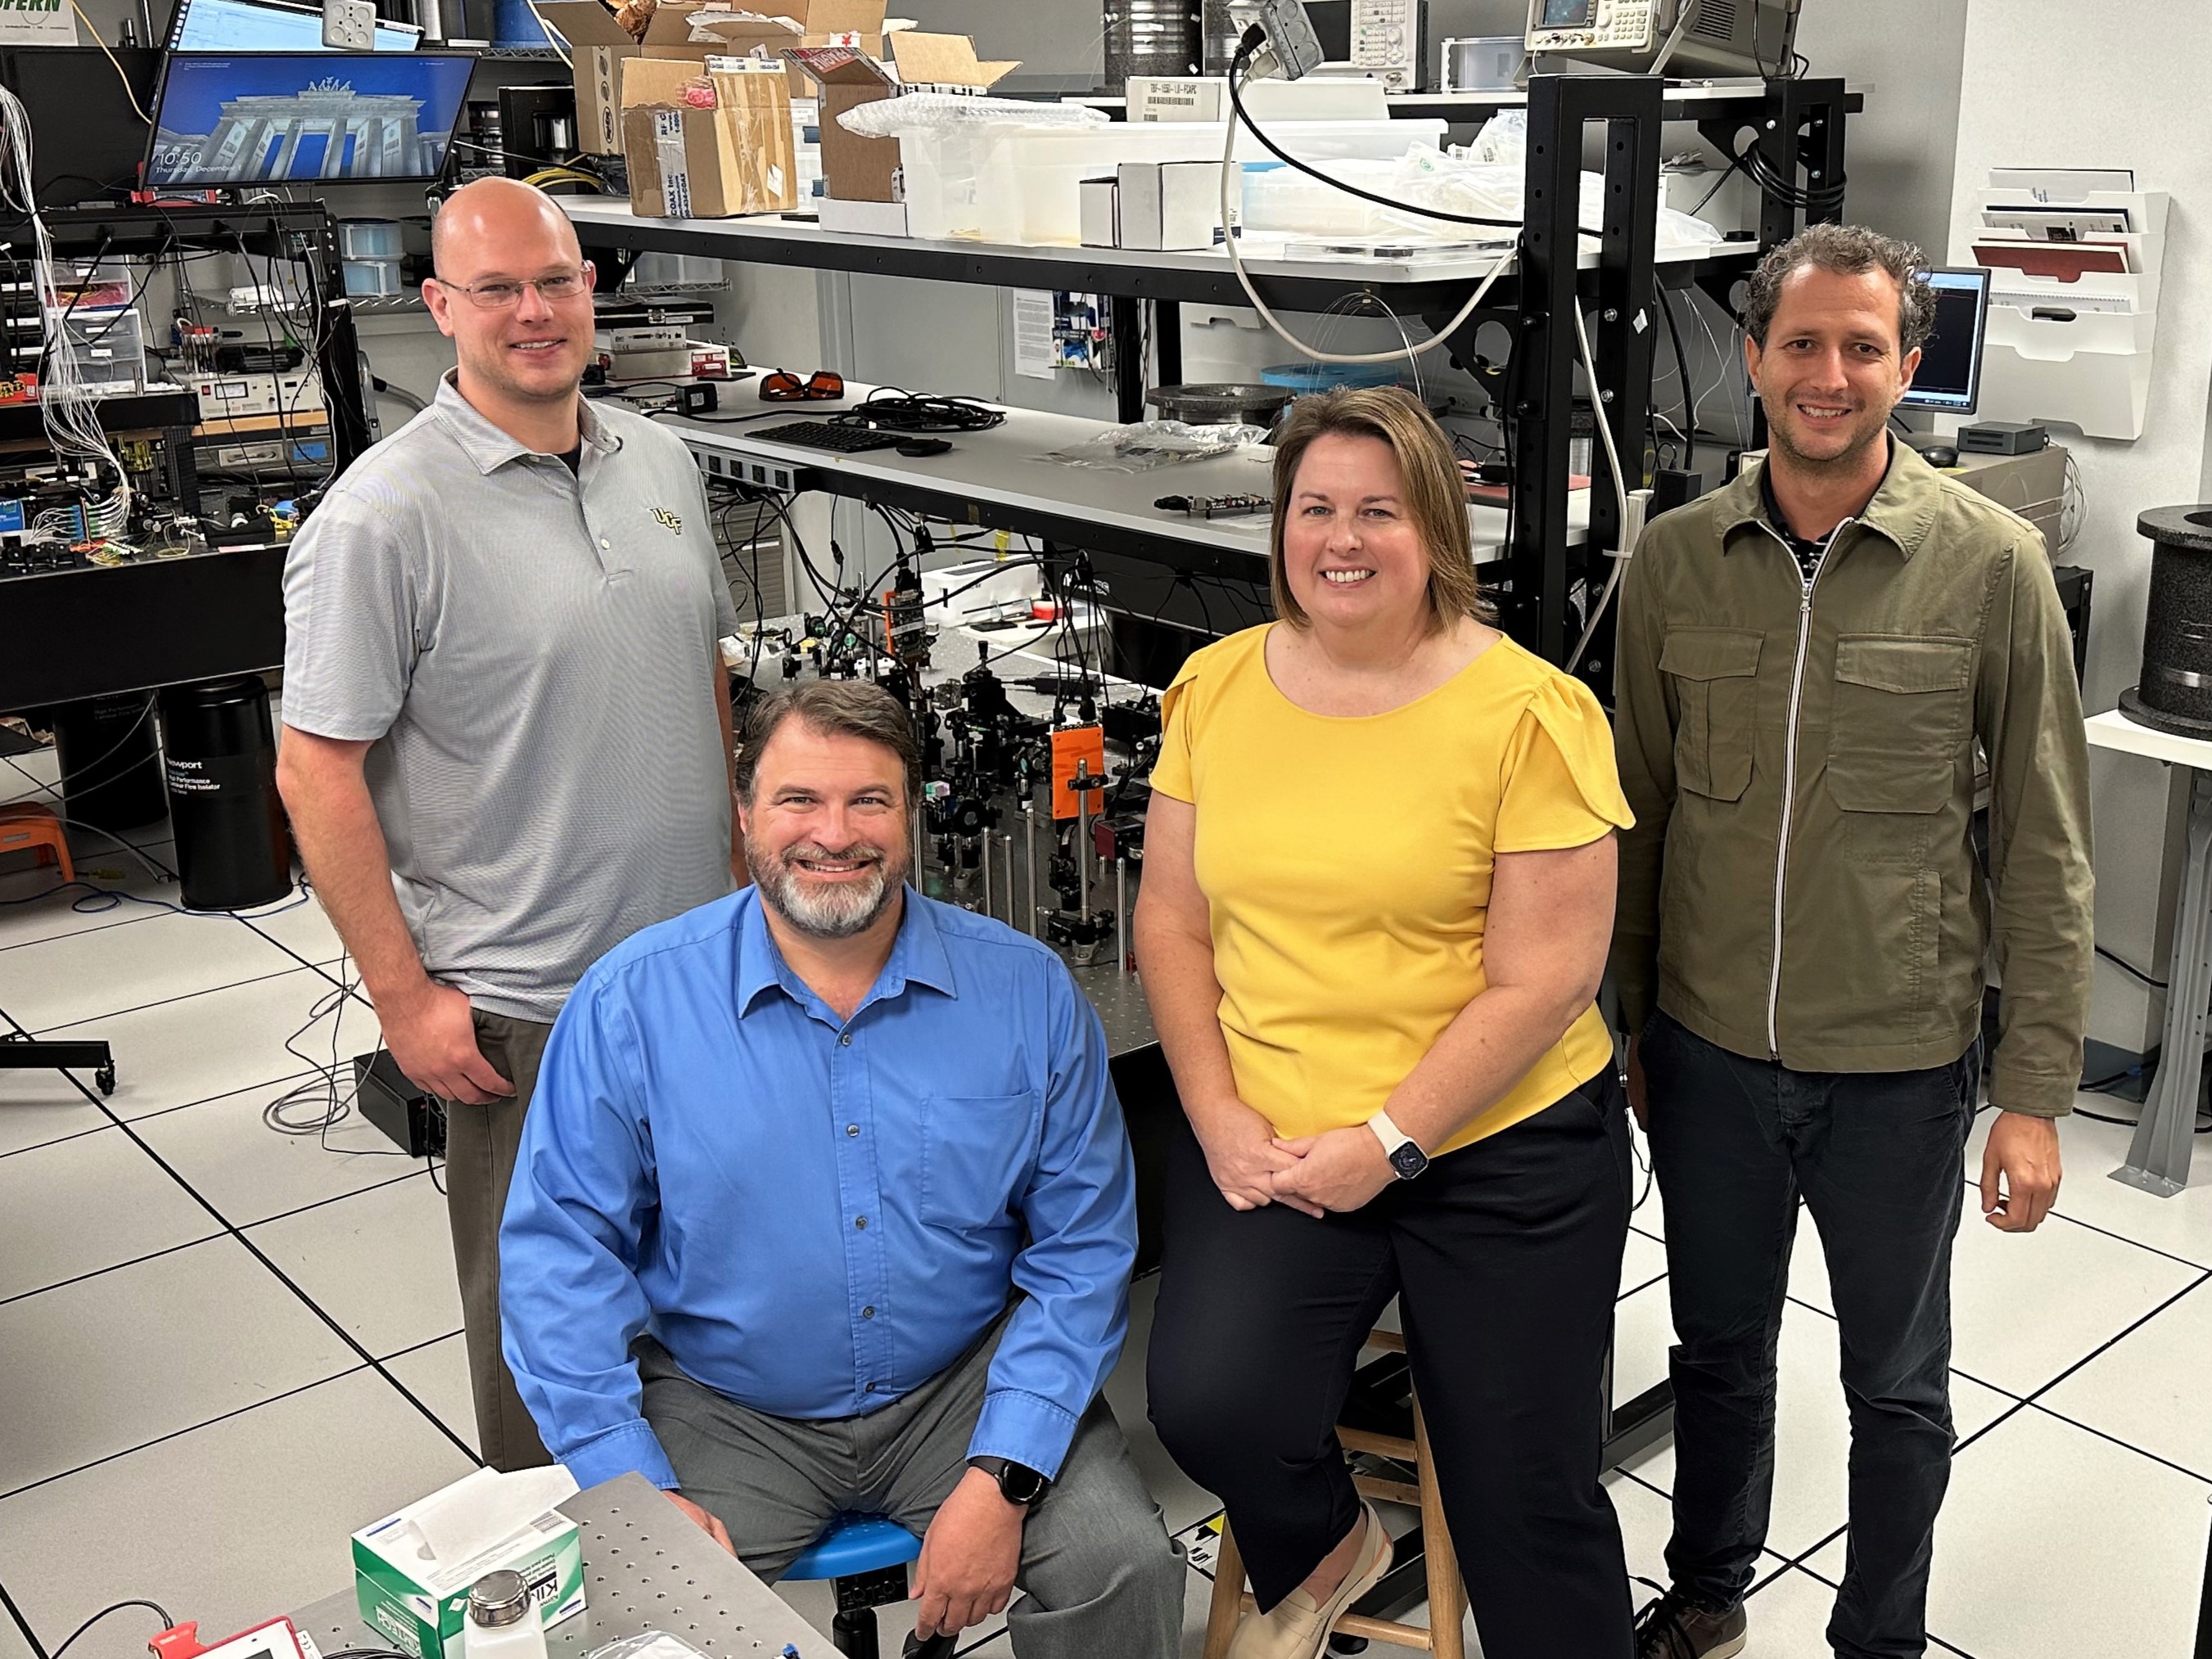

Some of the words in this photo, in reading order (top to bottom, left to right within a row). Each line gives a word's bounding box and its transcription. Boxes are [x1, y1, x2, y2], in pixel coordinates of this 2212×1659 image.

[158, 152, 202, 165] 10:50
[669, 190, 678, 216] COAX
[650, 507, 682, 535] UCF
